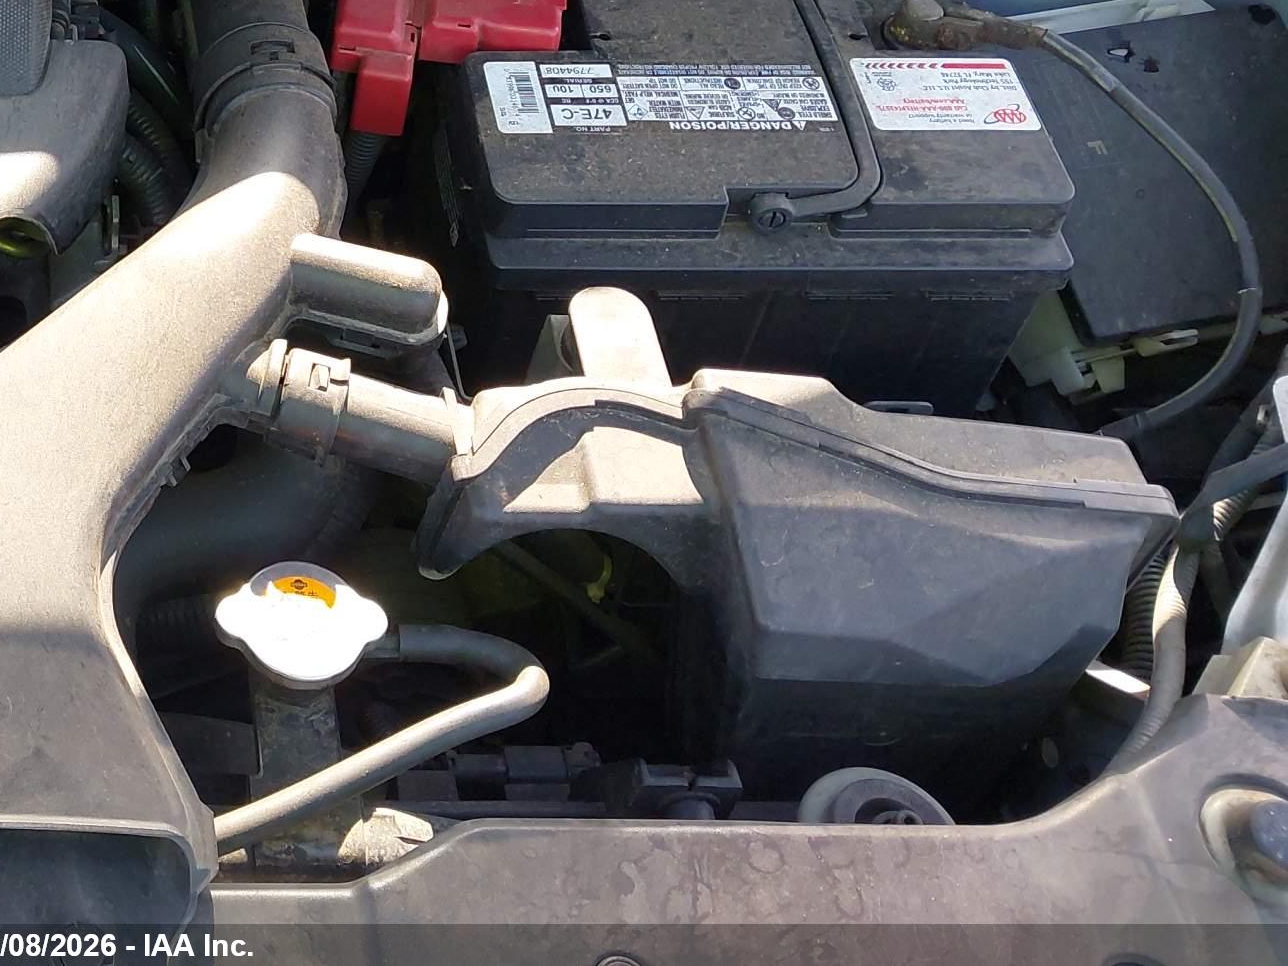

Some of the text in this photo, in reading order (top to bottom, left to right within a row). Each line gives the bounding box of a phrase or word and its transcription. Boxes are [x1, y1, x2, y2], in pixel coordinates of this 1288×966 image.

[545, 67, 594, 75] 7794408
[589, 85, 612, 94] 650
[561, 108, 613, 120] 47E-C
[996, 110, 1023, 123] AAA
[669, 121, 792, 130] DANGER/POISON
